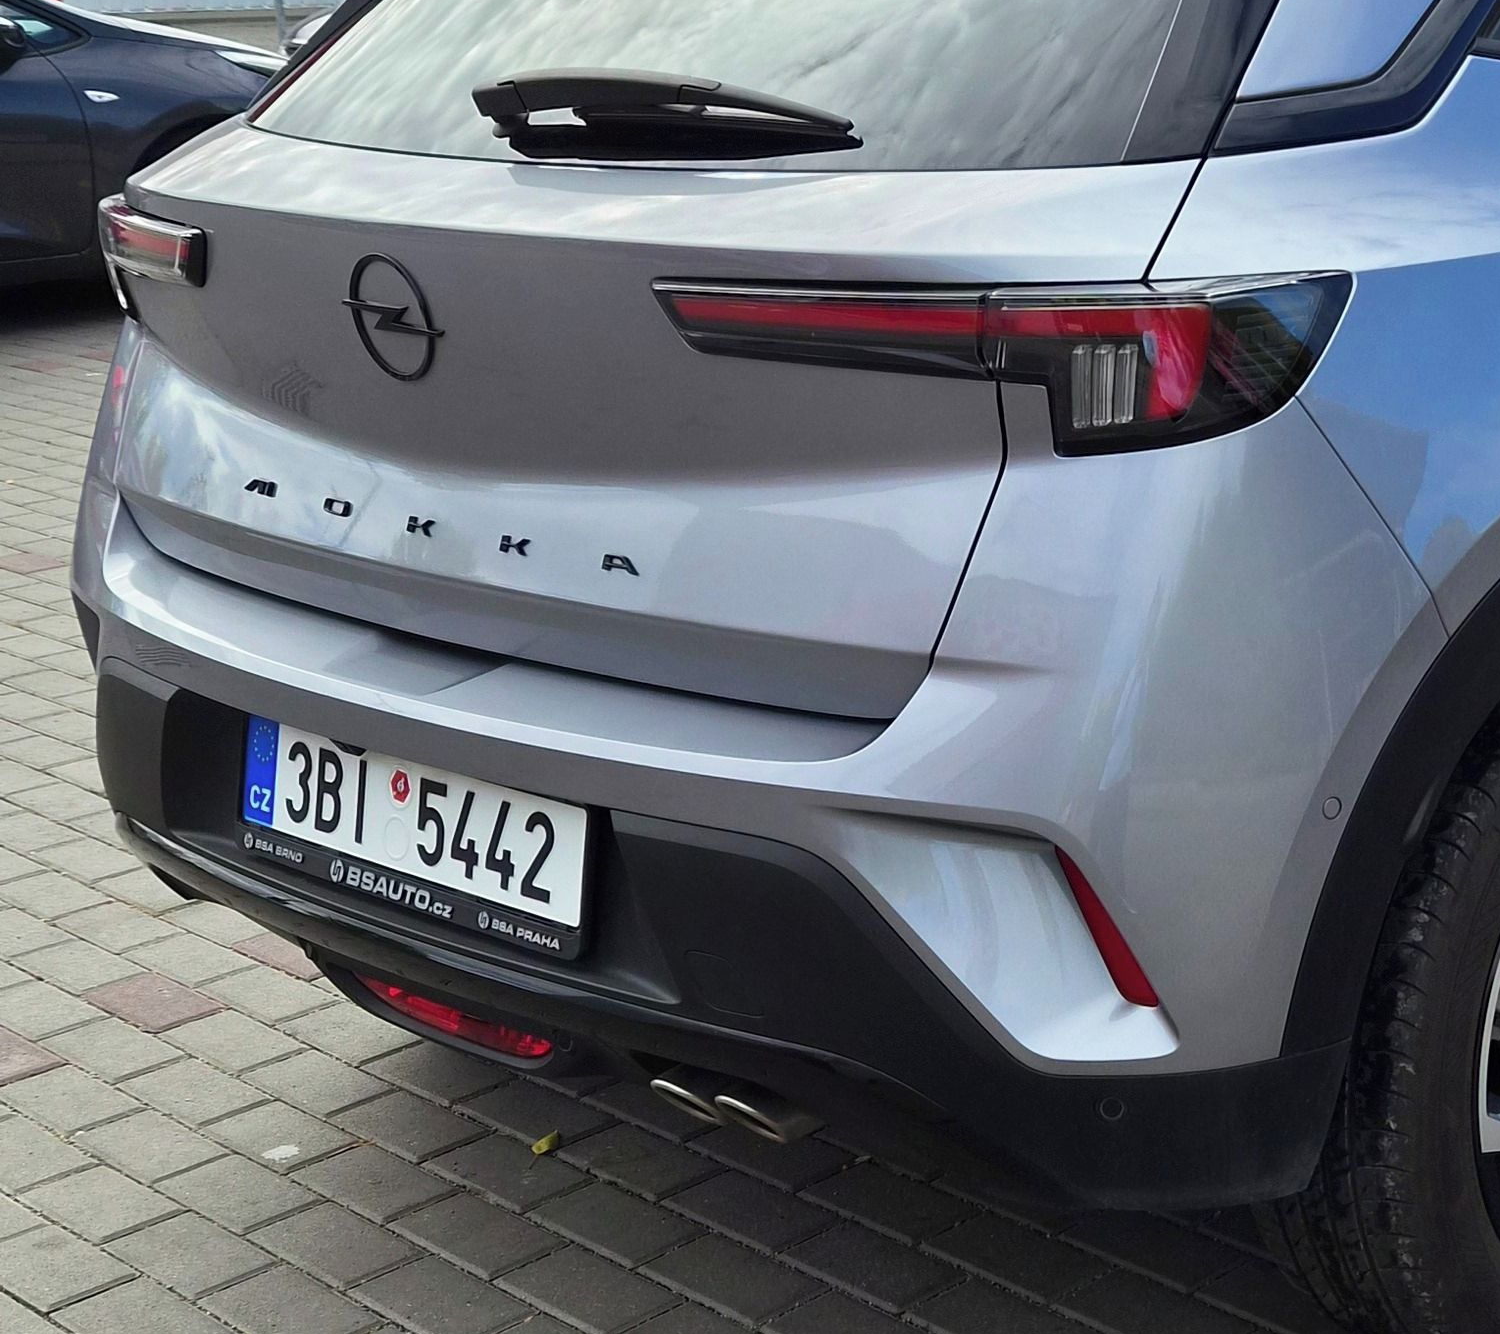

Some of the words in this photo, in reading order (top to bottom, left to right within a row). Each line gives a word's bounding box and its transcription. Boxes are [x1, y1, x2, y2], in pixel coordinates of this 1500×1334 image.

[243, 477, 640, 577] MOKKA
[249, 783, 272, 814] CZ
[285, 741, 367, 845] 3BI
[417, 779, 555, 904] 5442
[254, 838, 275, 855] BSA
[275, 845, 303, 864] BRNO
[346, 867, 453, 919] BSAUTO.cz
[491, 917, 515, 936] BSA
[515, 926, 561, 951] PRAHA
